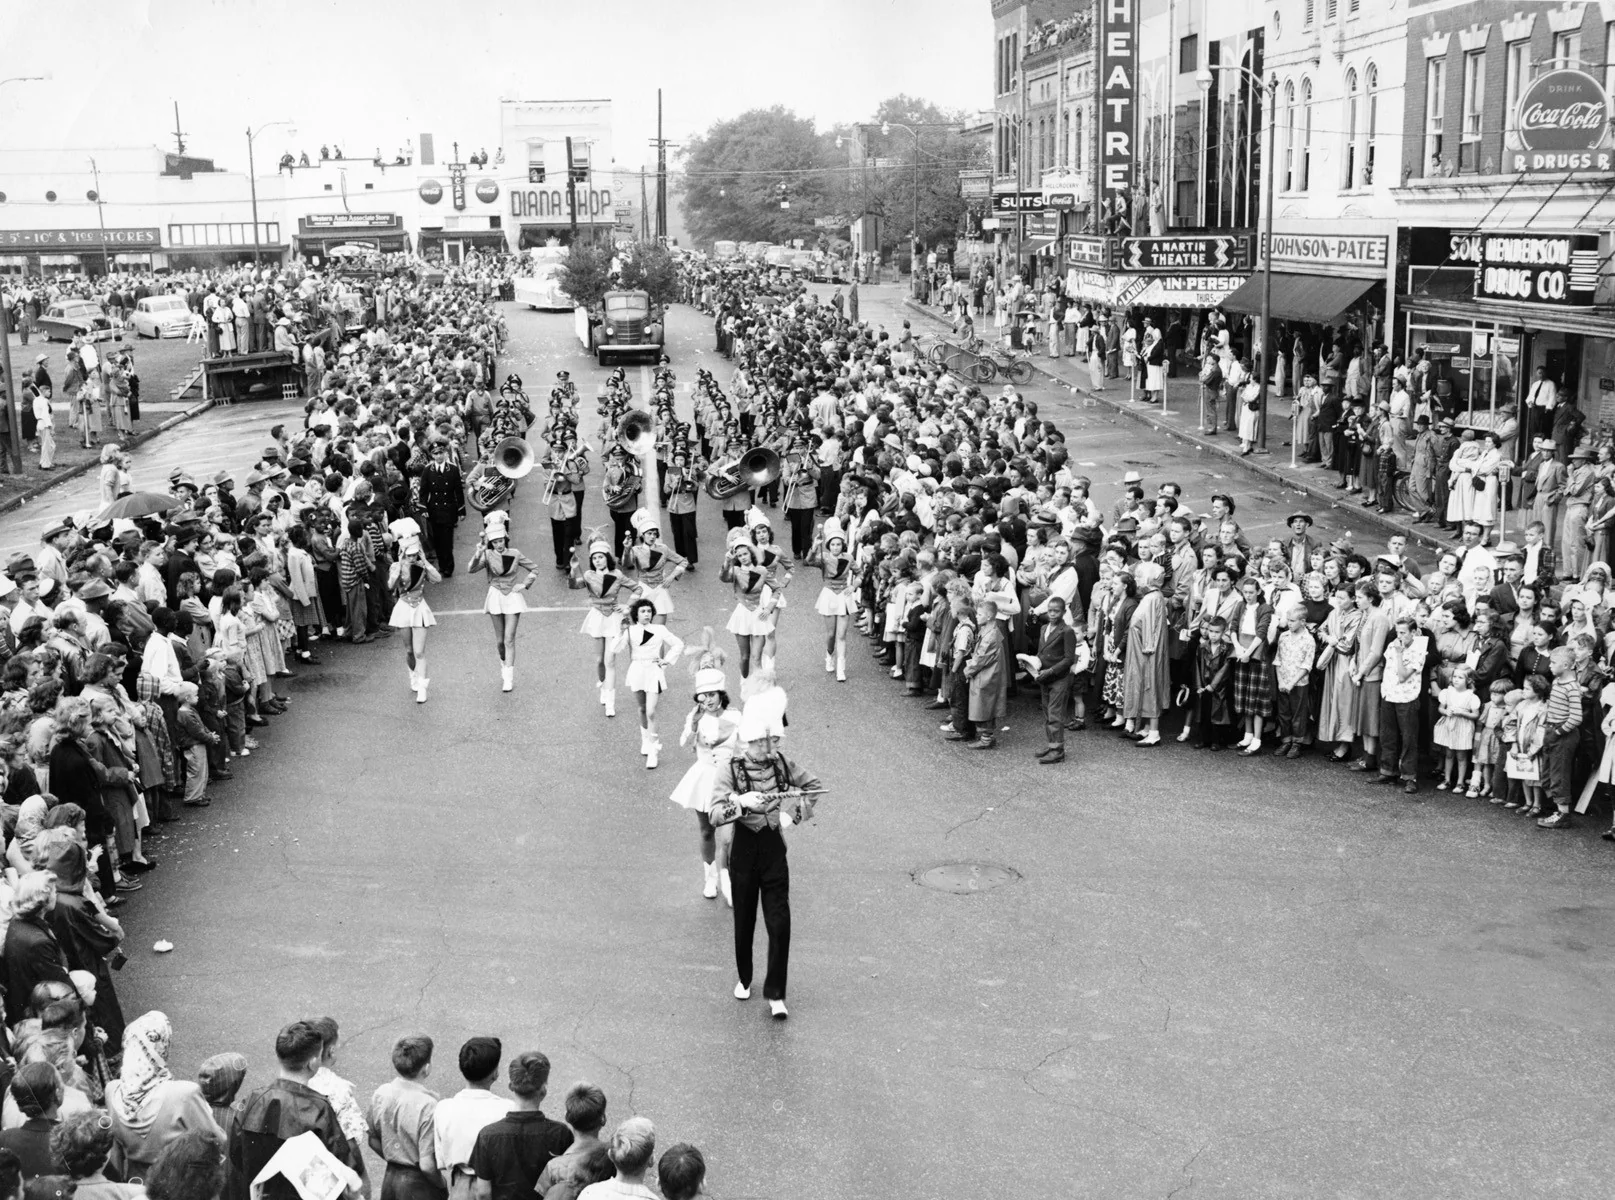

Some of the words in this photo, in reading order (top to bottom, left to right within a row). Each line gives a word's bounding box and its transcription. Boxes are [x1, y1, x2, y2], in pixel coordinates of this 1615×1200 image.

[1549, 85, 1582, 93] DRINK
[1522, 102, 1606, 129] Coca-Cola
[1533, 153, 1592, 169] DRUGS
[511, 190, 562, 216] DIANA
[1001, 196, 1042, 207] SUITS
[58, 232, 67, 243] &
[100, 231, 154, 243] STORES
[1151, 242, 1160, 252] A
[1163, 242, 1206, 252] MARTIN
[1271, 237, 1377, 260] JOHNSON-PATE
[1485, 237, 1569, 265] HENDERSON
[1151, 253, 1206, 265] THEATRE
[1120, 276, 1147, 305] LARUE
[1484, 267, 1533, 297] DRUG
